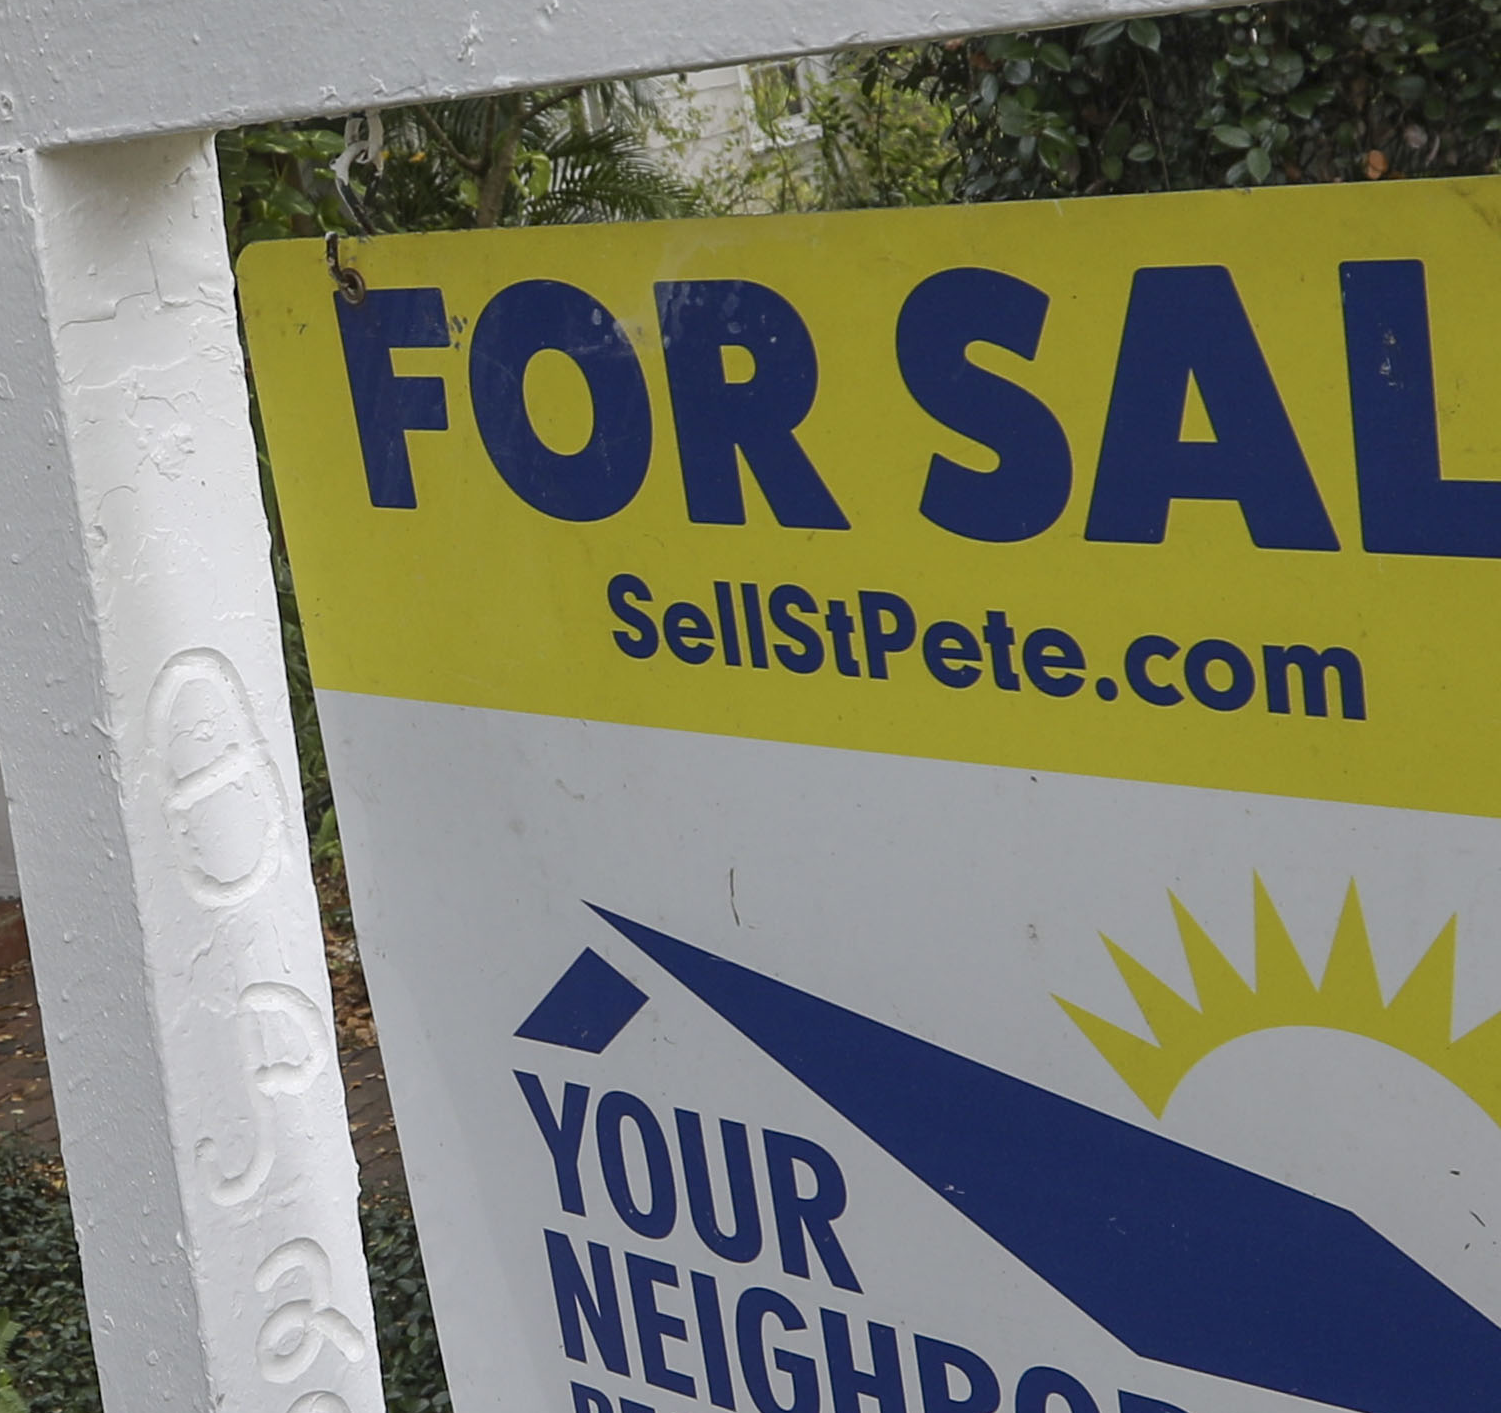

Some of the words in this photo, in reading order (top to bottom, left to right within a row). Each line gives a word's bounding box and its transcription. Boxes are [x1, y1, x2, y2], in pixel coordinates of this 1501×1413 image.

[333, 279, 851, 531] FOR
[606, 573, 1368, 721] SellStPete.com
[512, 1069, 864, 1294] YOUR
